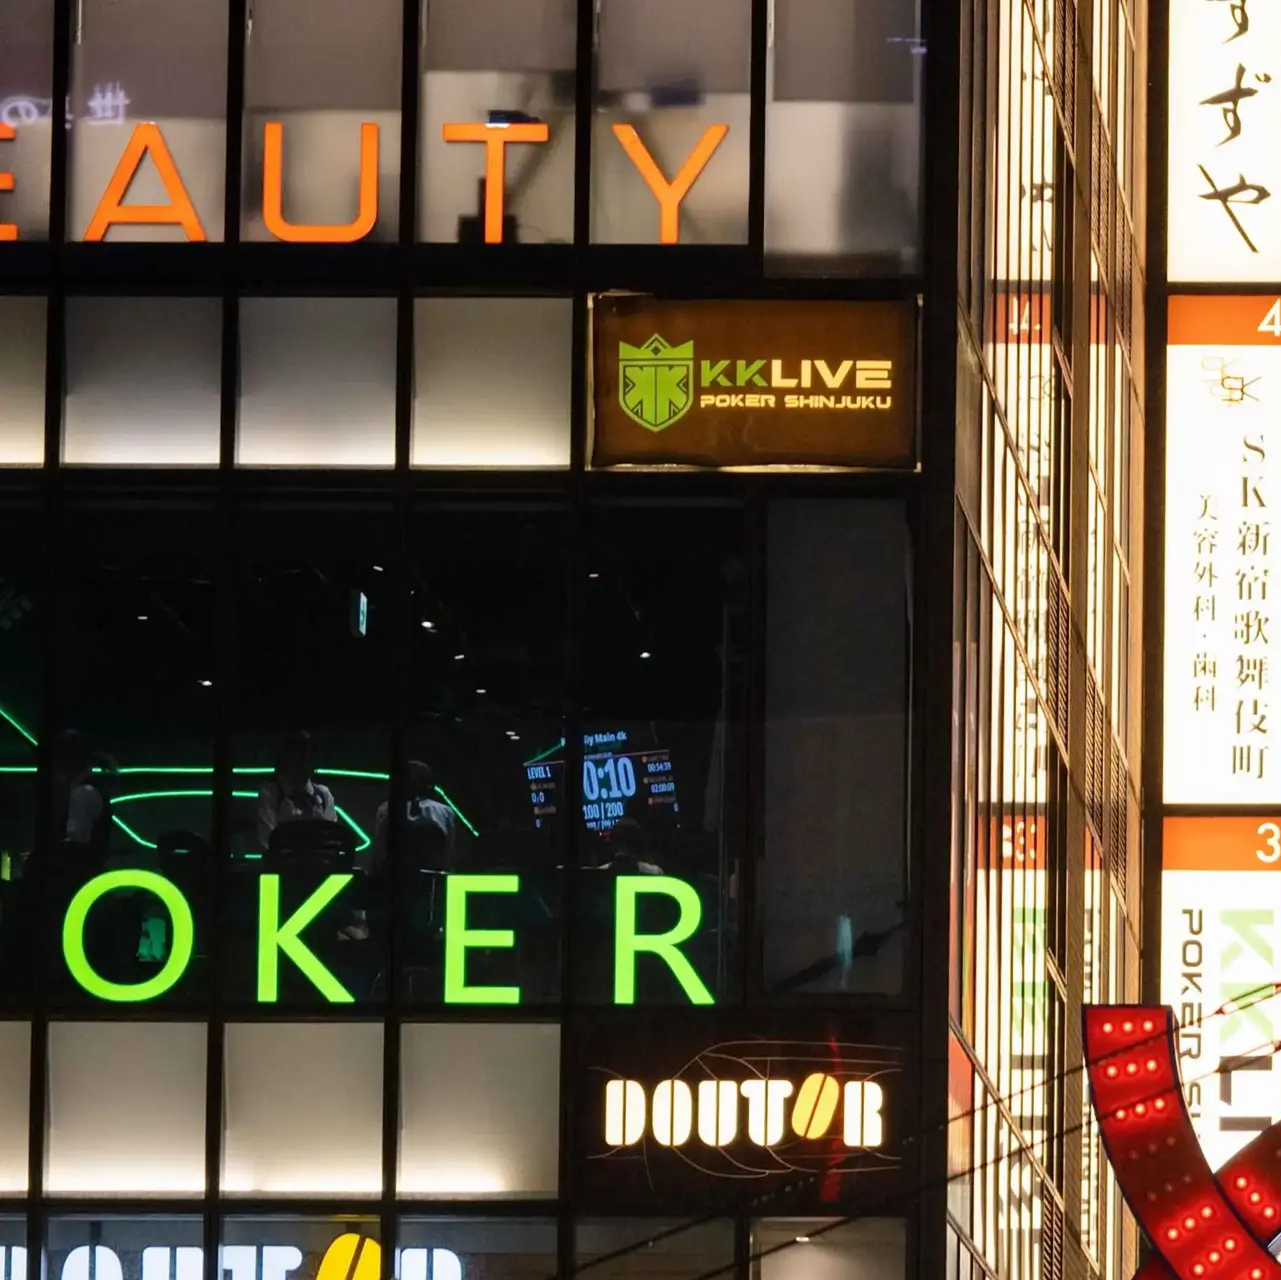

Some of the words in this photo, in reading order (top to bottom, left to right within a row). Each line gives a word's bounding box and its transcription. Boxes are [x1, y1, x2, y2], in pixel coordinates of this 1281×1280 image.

[0, 121, 729, 244] AUTY
[701, 359, 892, 388] KKLIVE
[701, 394, 775, 408] POKER
[784, 395, 892, 409] SHINJUKU
[1256, 823, 1281, 862] 3
[605, 1071, 884, 1148] DOUTOR
